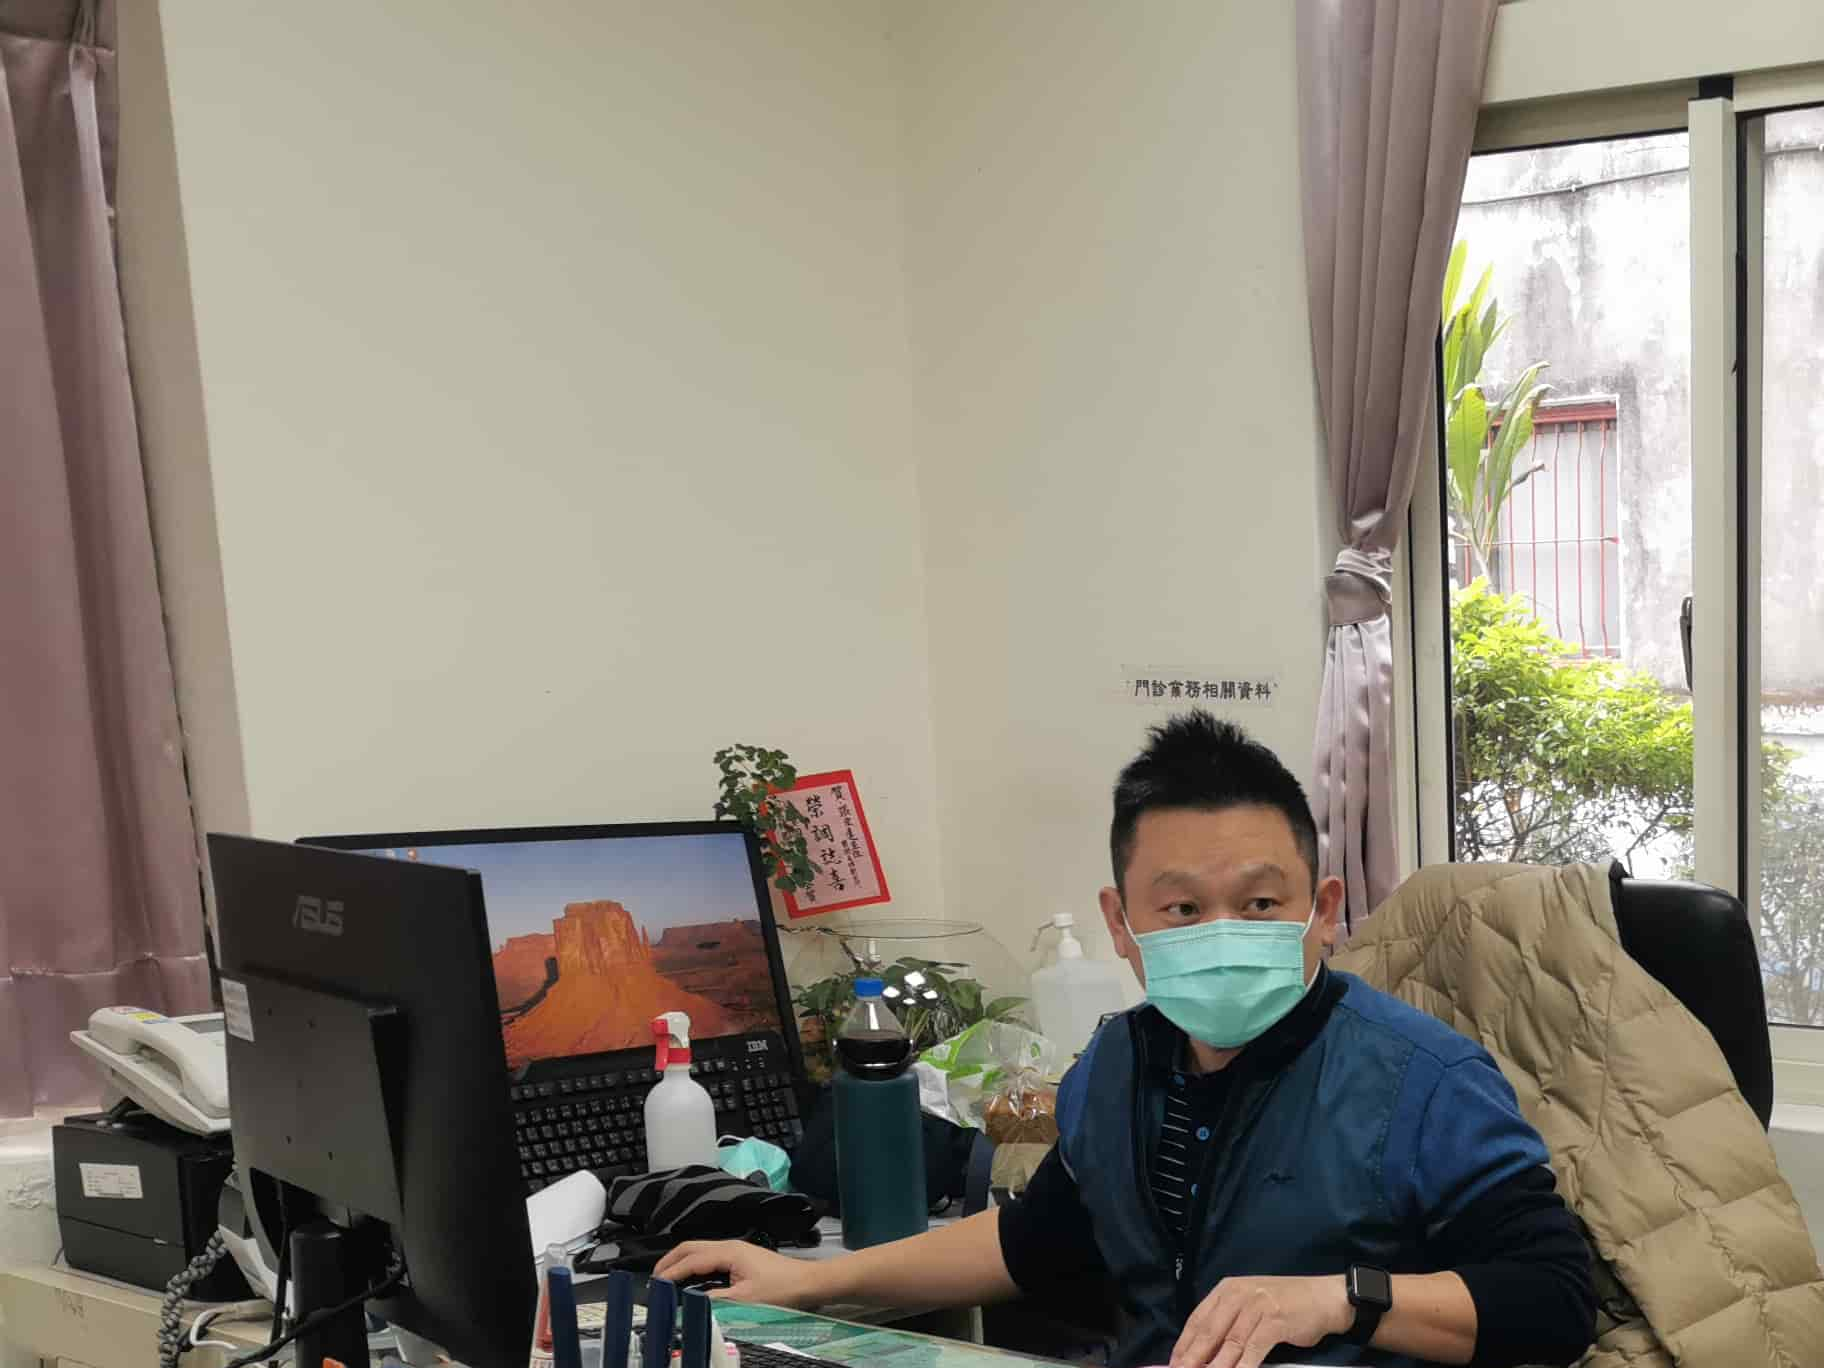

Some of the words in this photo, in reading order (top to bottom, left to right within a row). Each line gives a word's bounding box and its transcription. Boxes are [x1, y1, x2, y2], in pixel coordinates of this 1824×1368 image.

[1134, 679, 1272, 700] 門診業務相關資料
[292, 896, 344, 936] ASUS
[747, 1040, 768, 1052] IBM
